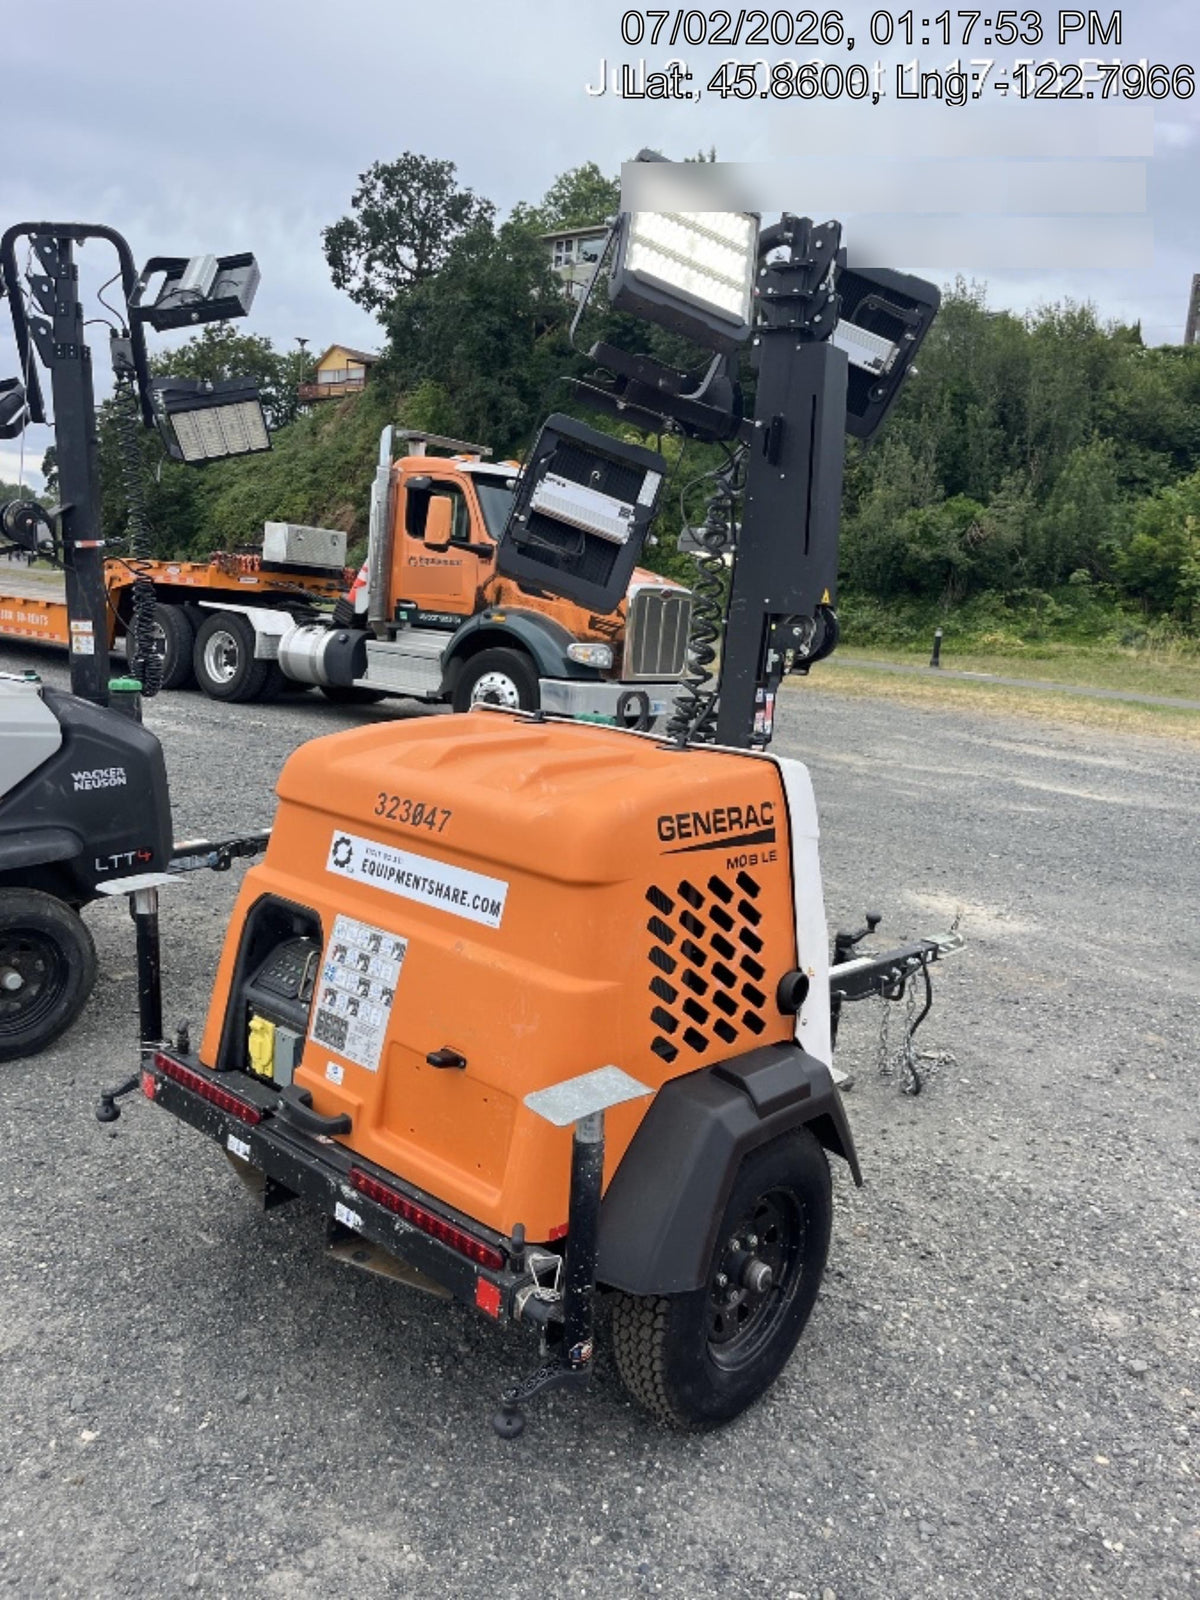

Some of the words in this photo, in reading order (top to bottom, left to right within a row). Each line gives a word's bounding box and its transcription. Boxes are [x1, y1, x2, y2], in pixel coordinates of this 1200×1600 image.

[71, 768, 126, 781] WACKER
[73, 776, 127, 791] NEUSON
[374, 792, 452, 833] 323047
[657, 802, 774, 841] GENERAC
[95, 851, 152, 871] LTT4
[726, 850, 778, 870] MOBLE
[360, 858, 502, 918] EQUIPMENTSHARE.COM
